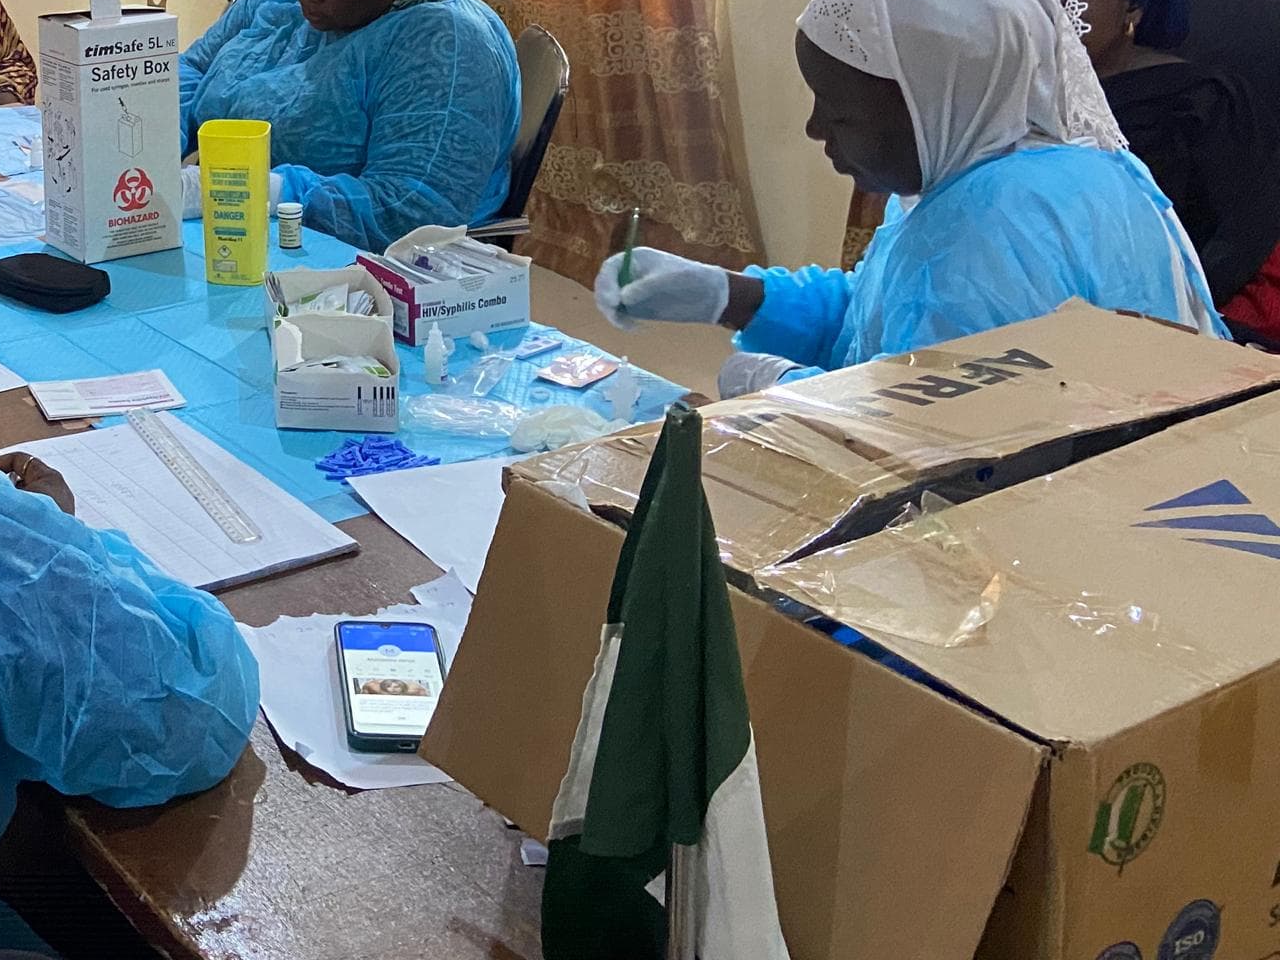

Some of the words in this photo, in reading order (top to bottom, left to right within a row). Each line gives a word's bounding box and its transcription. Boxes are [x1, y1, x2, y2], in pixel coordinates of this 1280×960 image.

[84, 39, 144, 58] timSafe
[148, 36, 164, 50] 5L
[91, 64, 138, 82] Safety
[143, 60, 170, 76] Box
[108, 211, 160, 228] BIOHAZARD
[213, 210, 245, 221] DANGER
[422, 301, 476, 318] HIV/Syphilis
[478, 295, 507, 309] Combo
[1174, 929, 1205, 955] ISO
